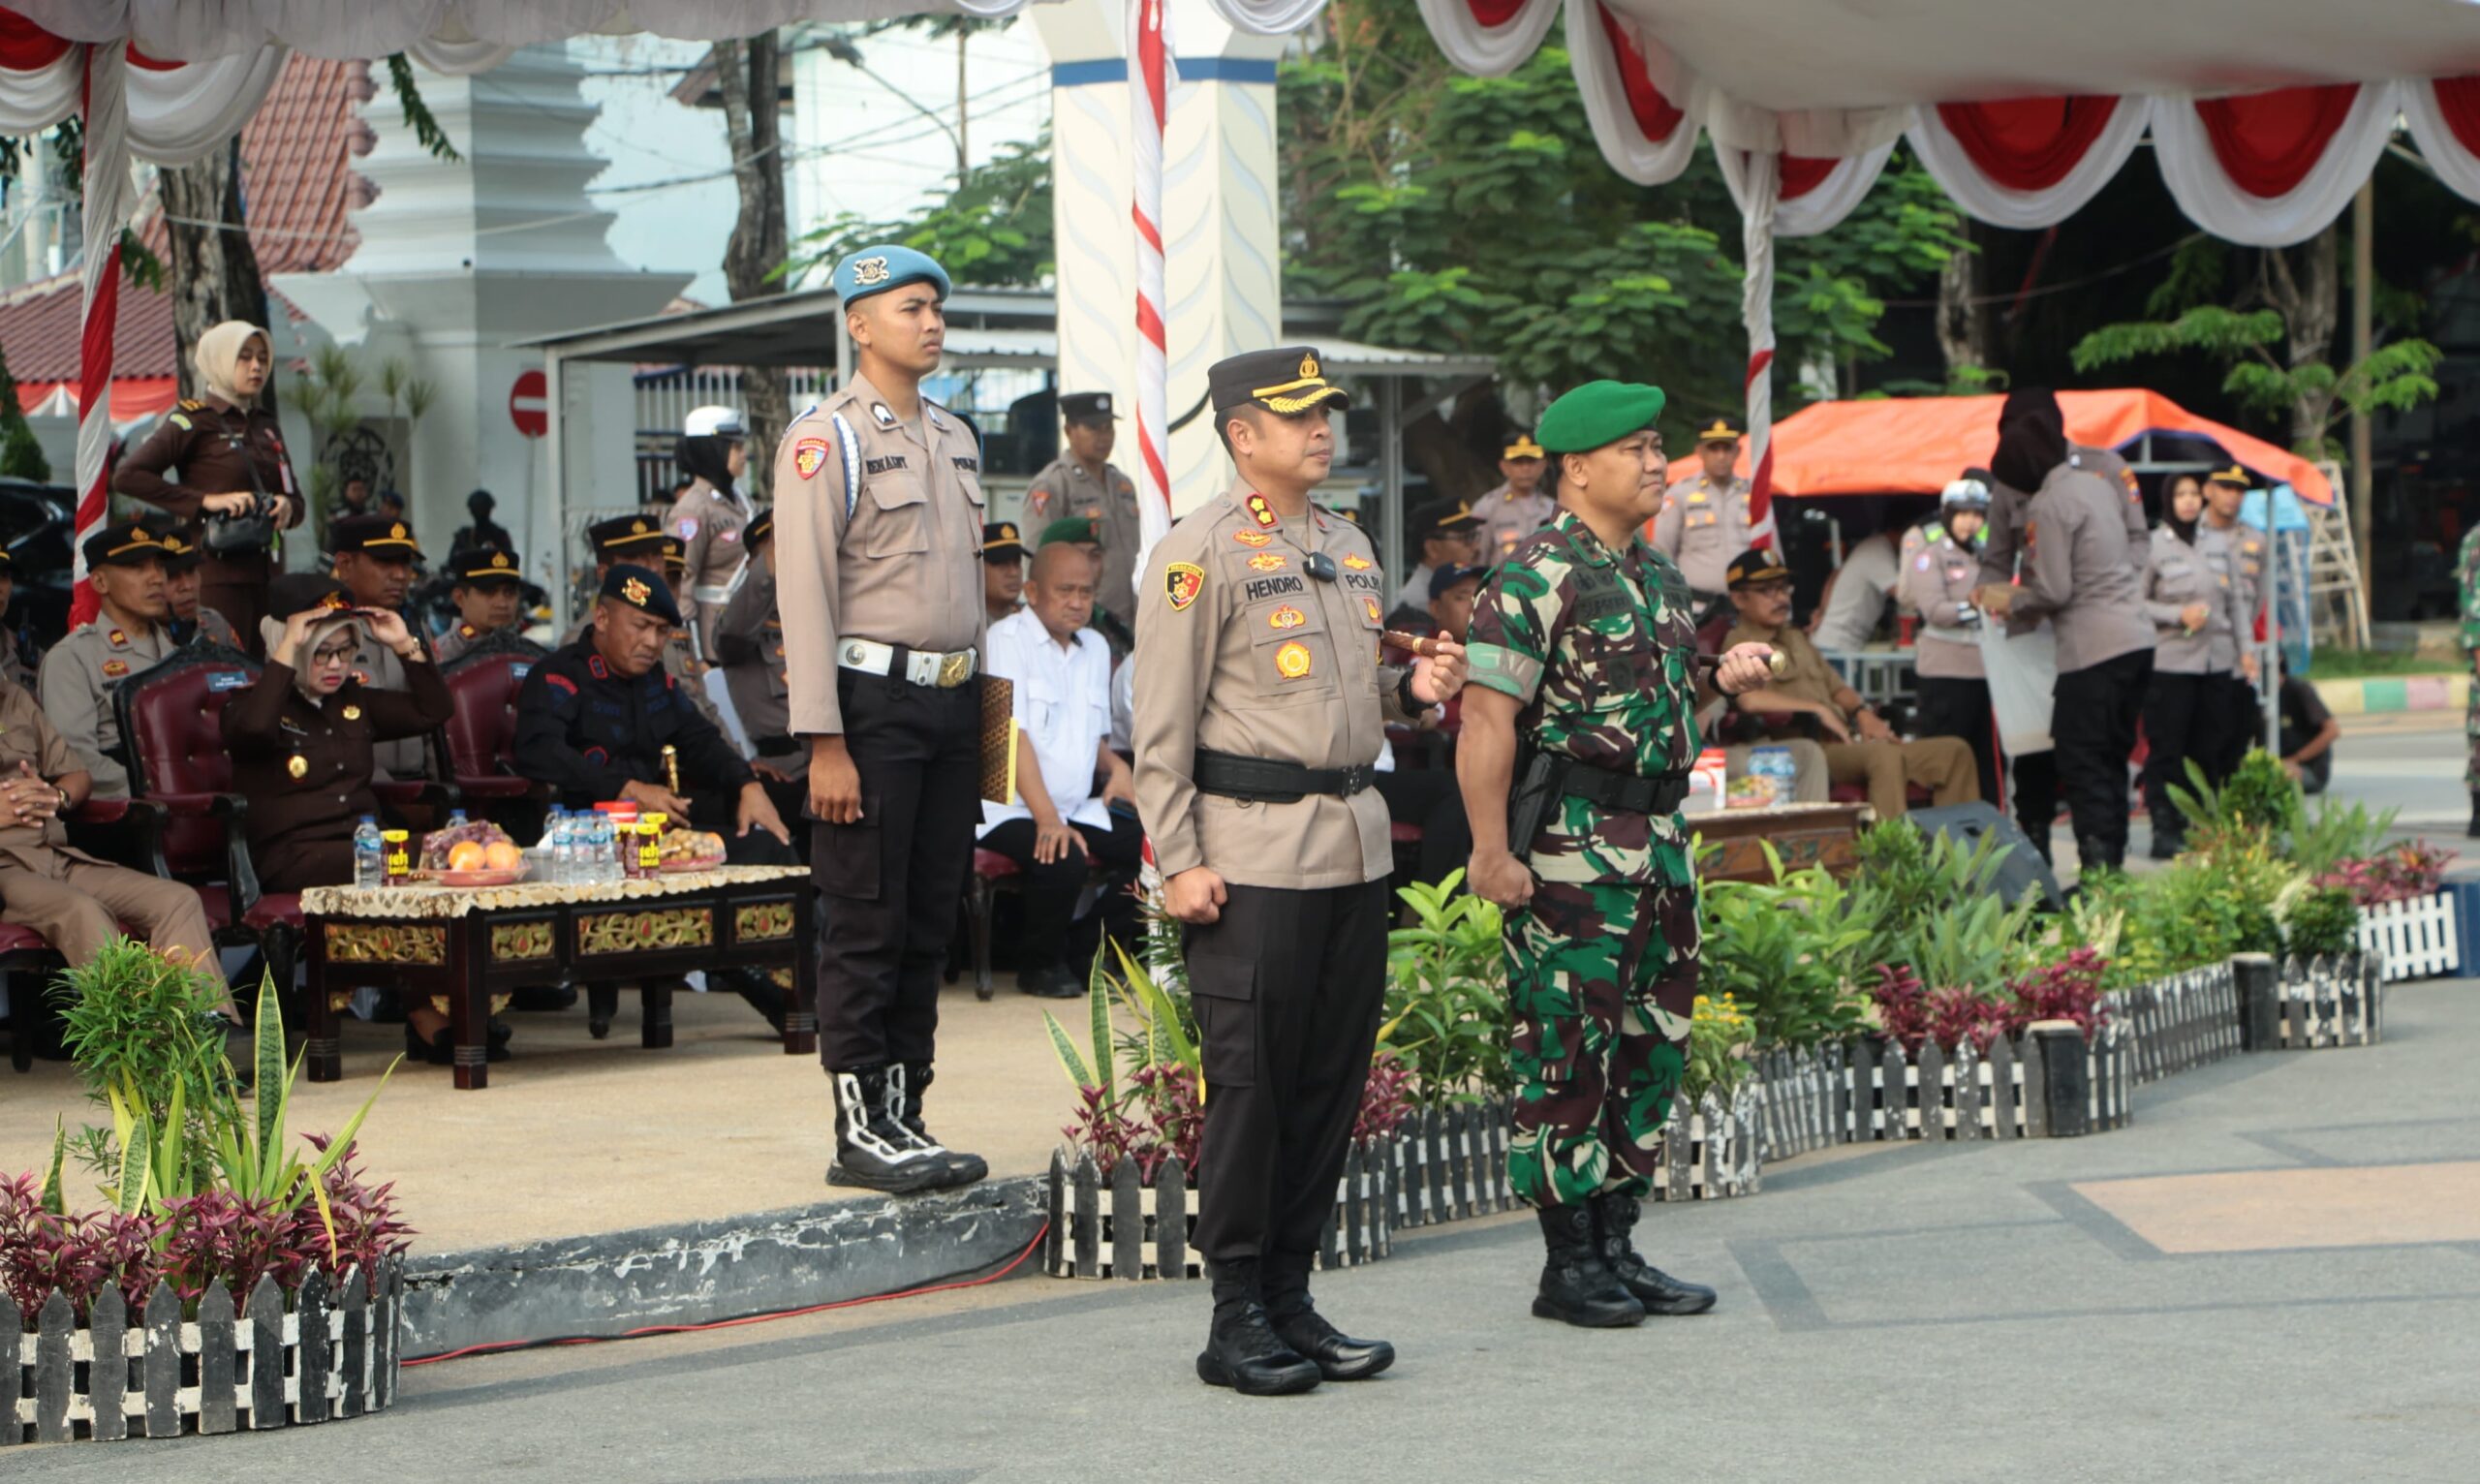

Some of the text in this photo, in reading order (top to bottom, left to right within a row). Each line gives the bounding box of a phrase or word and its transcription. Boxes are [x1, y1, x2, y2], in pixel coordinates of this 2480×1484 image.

[1246, 575, 1304, 602] HENDRO
[388, 848, 409, 865] teh
[638, 841, 660, 858] teh
